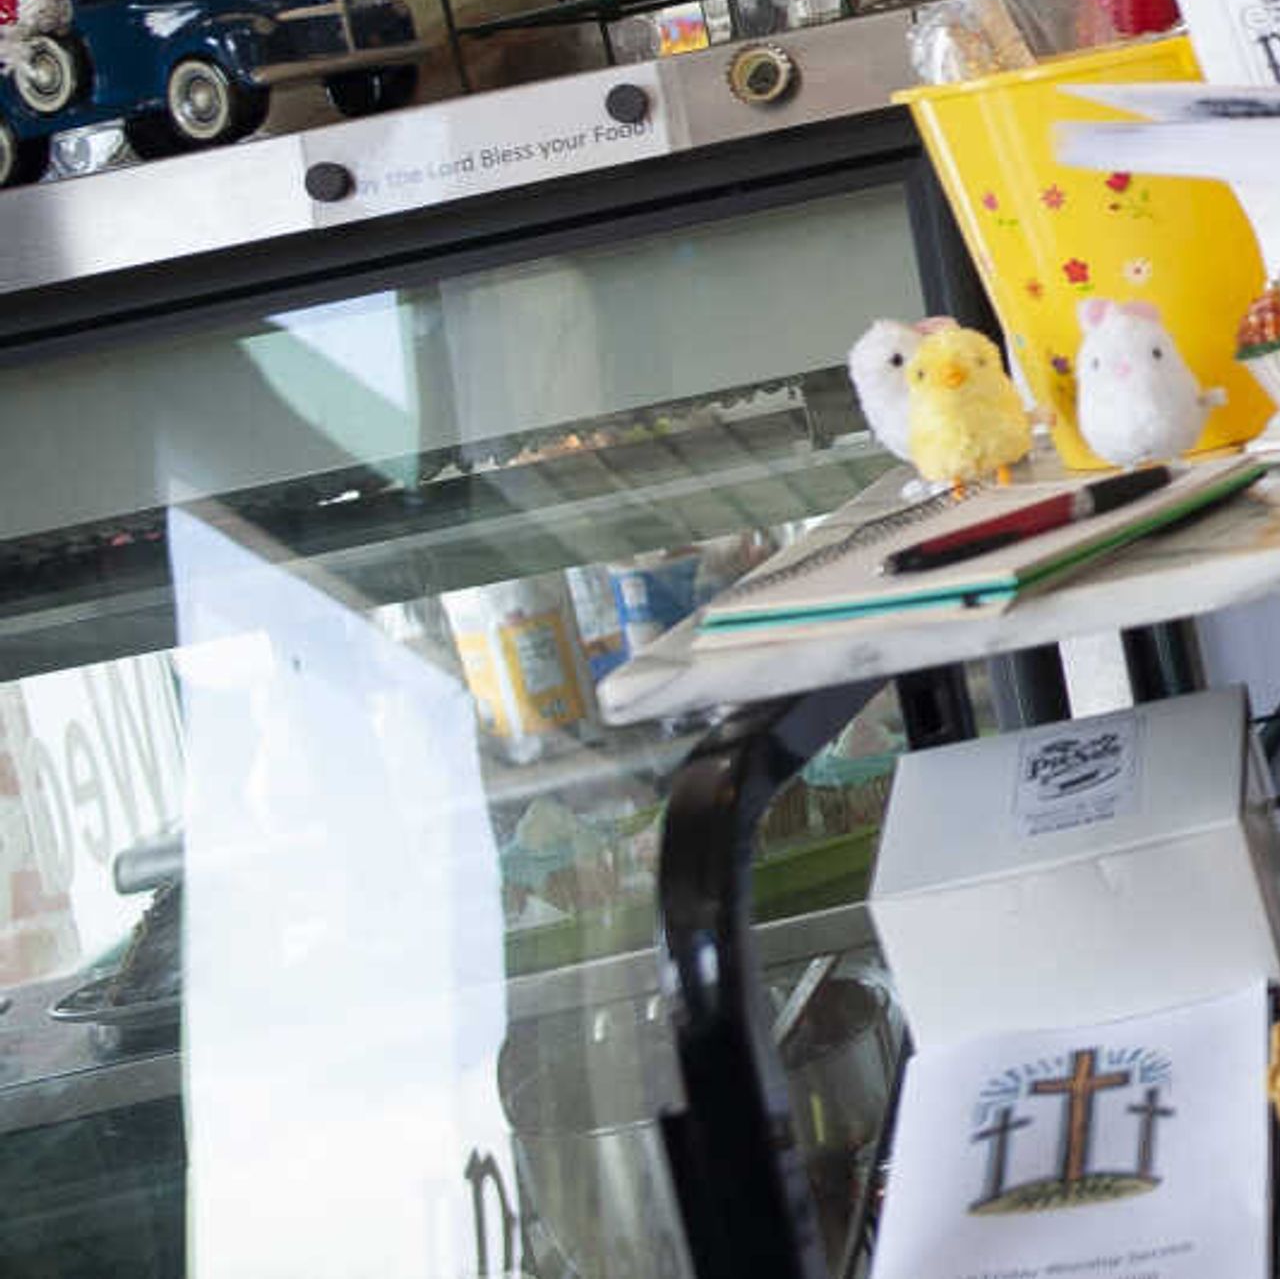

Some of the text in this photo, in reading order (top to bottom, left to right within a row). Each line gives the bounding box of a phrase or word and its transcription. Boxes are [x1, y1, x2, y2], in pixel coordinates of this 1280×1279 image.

[386, 165, 423, 189] the
[427, 153, 474, 179] Lord
[479, 143, 534, 171] Bless
[536, 134, 588, 163] your
